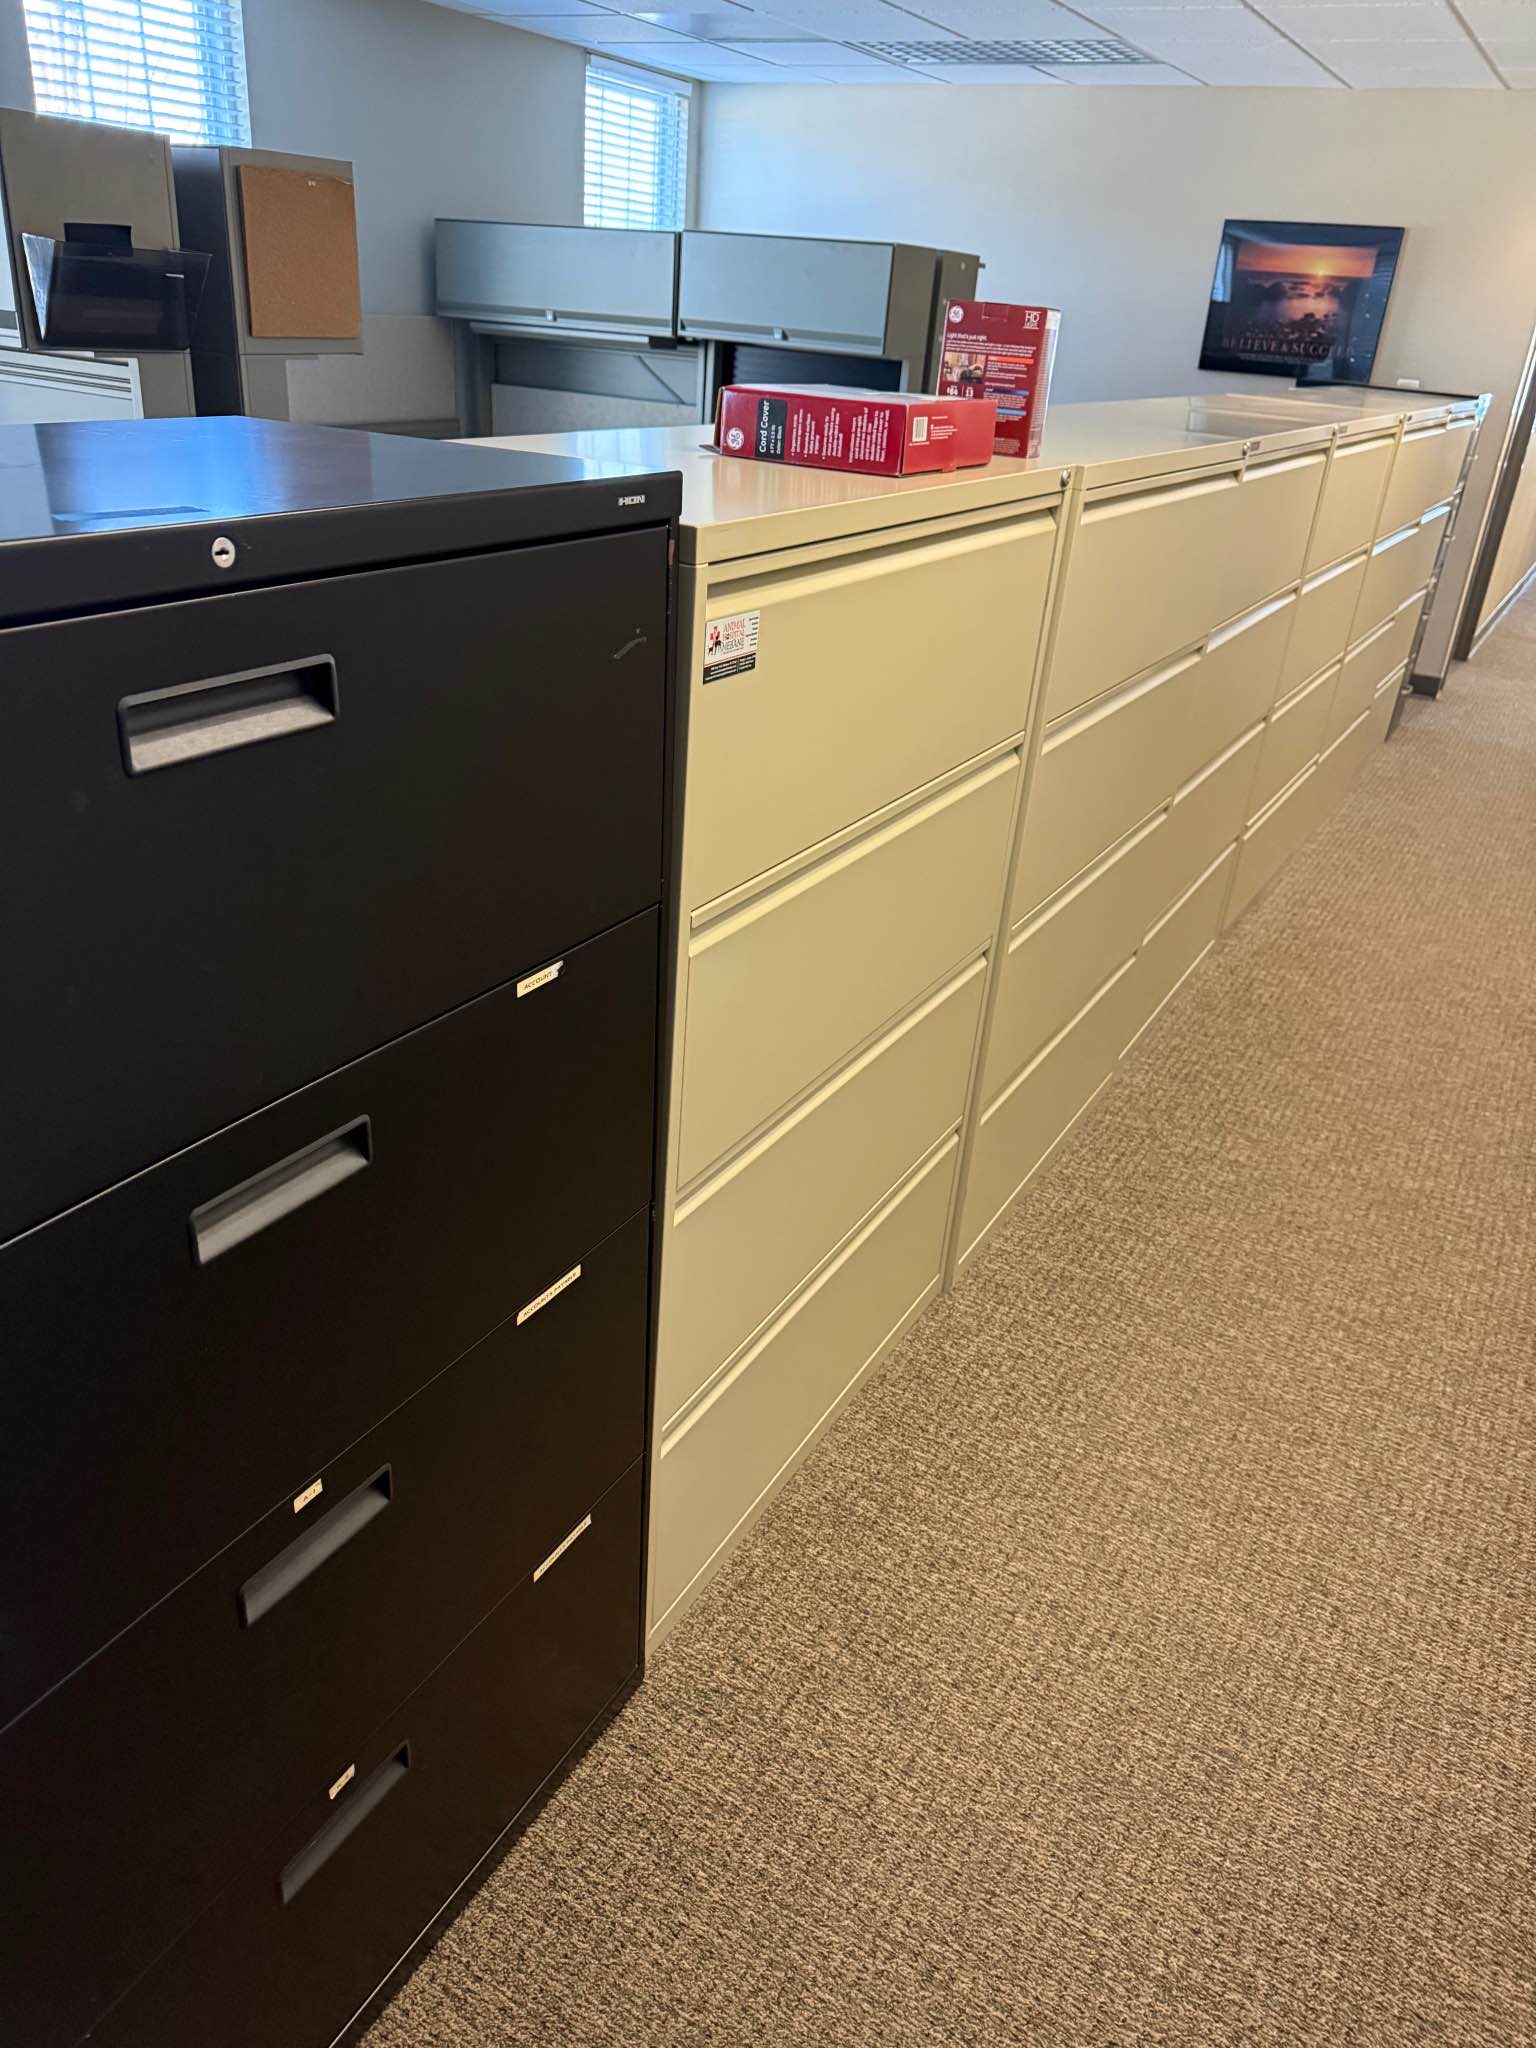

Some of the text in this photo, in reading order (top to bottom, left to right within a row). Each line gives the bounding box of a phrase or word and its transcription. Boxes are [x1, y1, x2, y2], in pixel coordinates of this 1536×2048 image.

[1025, 310, 1040, 323] HD
[759, 400, 770, 453] Cord Cover
[723, 618, 746, 633] ANIMAL
[524, 971, 553, 990] ACCOUNT
